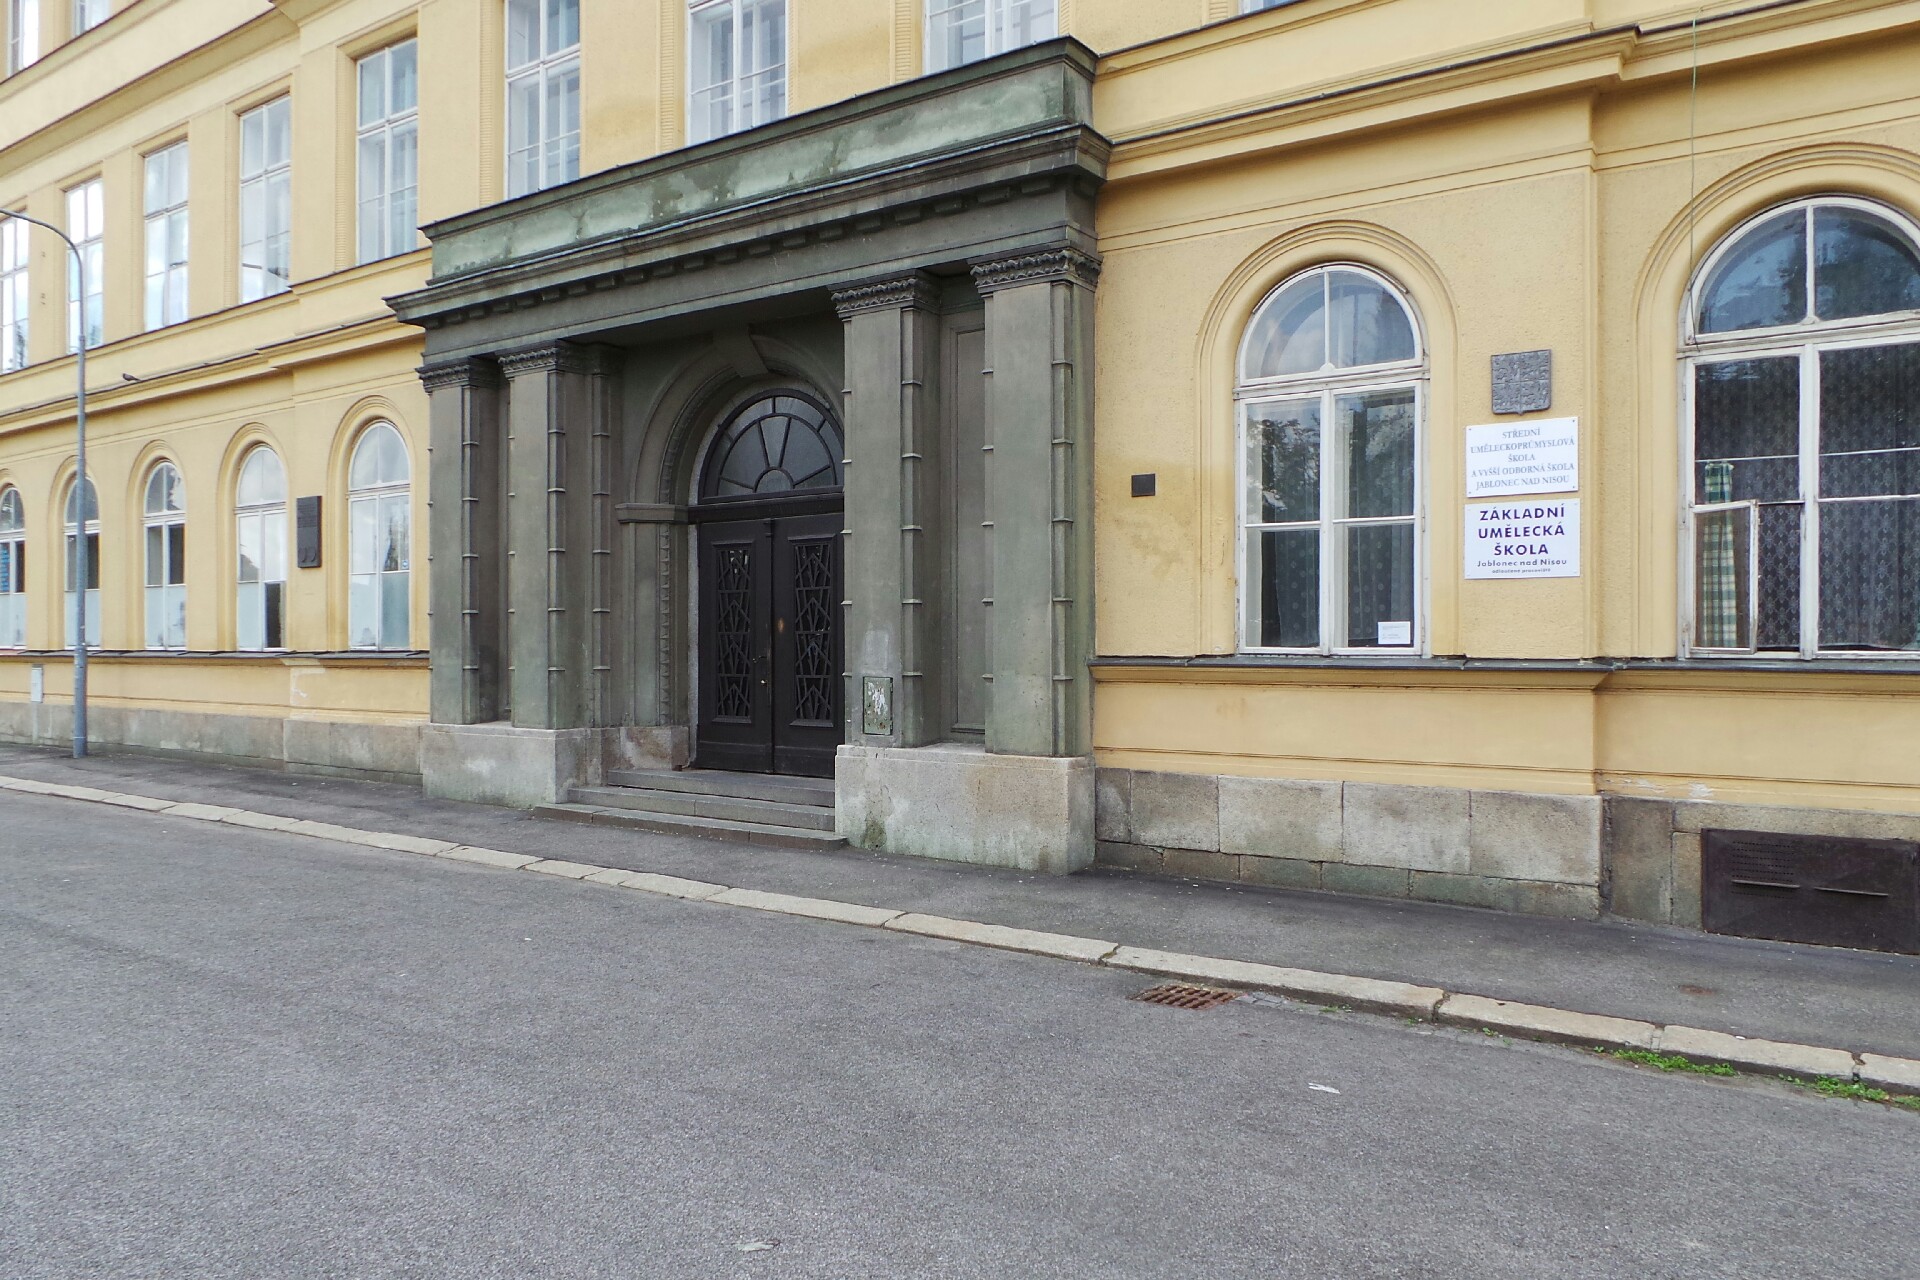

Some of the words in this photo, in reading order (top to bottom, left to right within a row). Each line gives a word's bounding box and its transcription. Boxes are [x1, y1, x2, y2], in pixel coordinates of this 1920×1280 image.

[1502, 427, 1541, 439] STŘEDNÍ
[1508, 453, 1535, 462] ŠKOLA
[1471, 469, 1477, 477] A
[1478, 467, 1500, 477] VYŠŠÍ
[1502, 465, 1544, 475] ODBORNÁ
[1547, 462, 1575, 472] ŠKOLA
[1475, 478, 1520, 490] JABLONEC
[1521, 477, 1541, 486] NAD
[1542, 475, 1570, 484] NISOU
[1479, 502, 1565, 521] ZÁKLADNÍ
[1478, 521, 1565, 538] UMĚLECKÁ
[1493, 542, 1549, 556] ŠKOLA
[1540, 558, 1567, 566] Nisou
